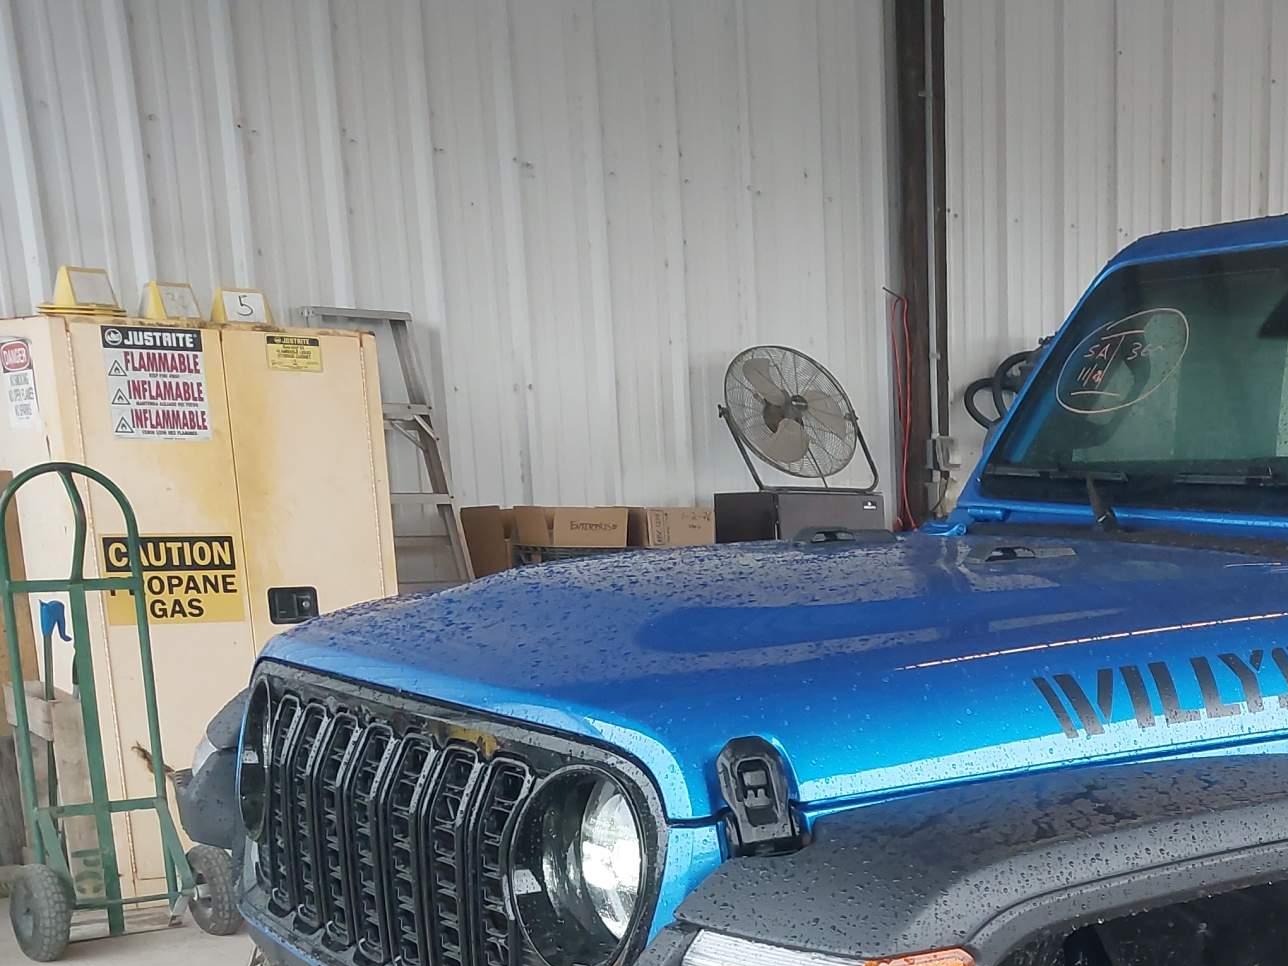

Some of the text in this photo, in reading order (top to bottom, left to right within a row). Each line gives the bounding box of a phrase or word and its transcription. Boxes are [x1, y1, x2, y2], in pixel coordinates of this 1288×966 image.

[237, 294, 254, 317] 5
[124, 330, 195, 347] JUSTRITE
[124, 351, 200, 374] FLAMMABLE
[127, 379, 204, 402] INFLAMABLE
[131, 408, 208, 430] INFLAMMABLE
[149, 598, 204, 618] GAS
